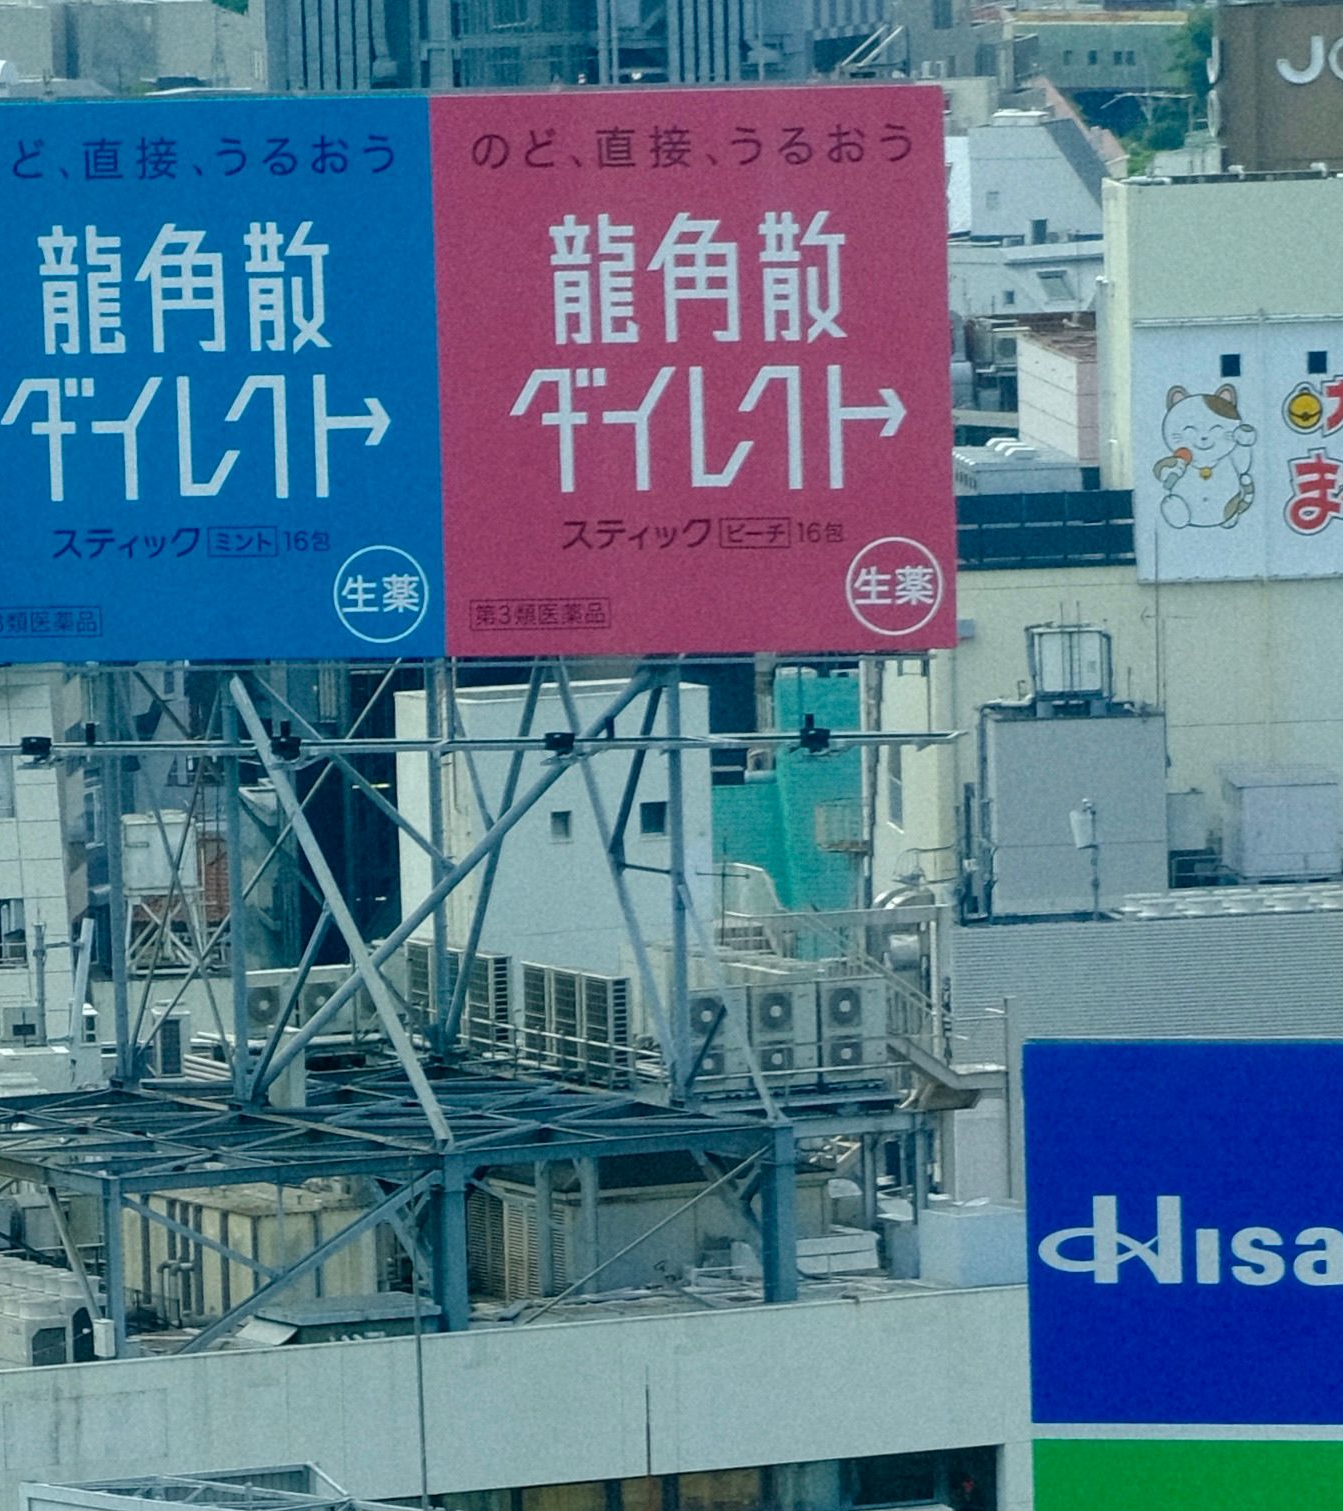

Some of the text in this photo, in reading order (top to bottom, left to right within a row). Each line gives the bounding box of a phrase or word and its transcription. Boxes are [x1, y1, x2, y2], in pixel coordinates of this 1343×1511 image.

[471, 123, 914, 172] のど、直接、うるおう
[37, 220, 332, 355] 龍角散
[549, 210, 847, 345] 龍角散
[0, 373, 392, 501] ダイレクト
[510, 364, 905, 492] ダイレクト
[52, 526, 331, 561] スティック ミント 16包
[562, 517, 844, 551] スティック ピーチ 16包
[341, 575, 423, 616] 生薬
[854, 565, 936, 606] 生薬
[472, 602, 608, 630] 第3類医薬品
